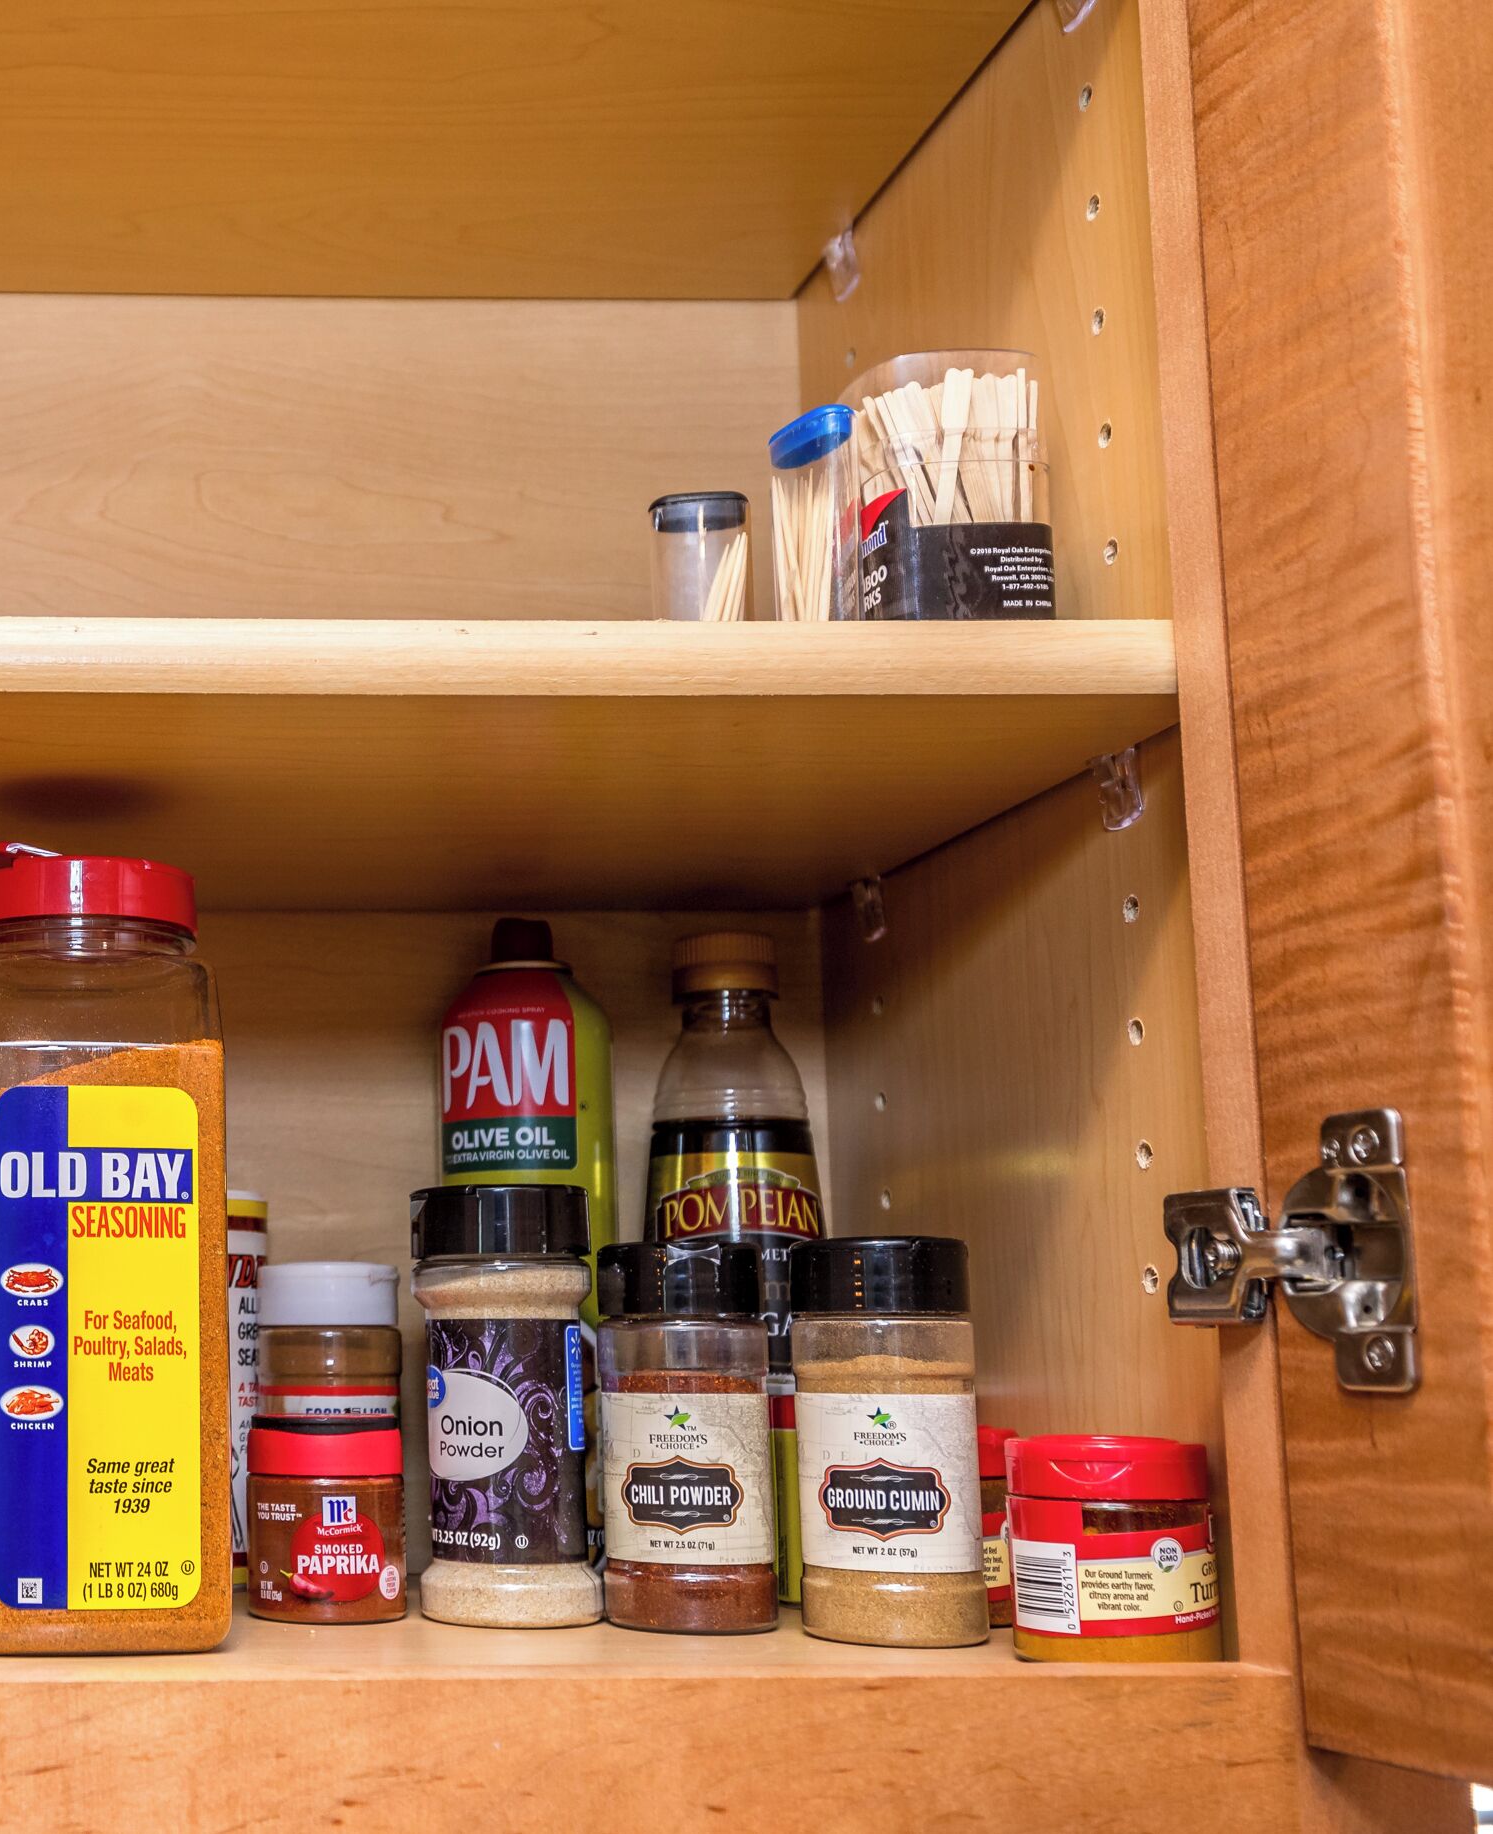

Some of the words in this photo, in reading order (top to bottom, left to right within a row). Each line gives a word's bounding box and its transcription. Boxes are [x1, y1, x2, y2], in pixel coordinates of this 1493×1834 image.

[992, 547, 1011, 555] Royal
[1000, 556, 1035, 564] Distributed
[984, 565, 1003, 573] Royal
[1003, 565, 1016, 573] Oak
[1003, 600, 1023, 608] MADE
[442, 1018, 570, 1114] PAM
[452, 1127, 509, 1150] OLIVE
[515, 1126, 556, 1147] OIL
[453, 1151, 479, 1164] EXTRA
[479, 1150, 515, 1162] VIRGIN
[516, 1149, 550, 1161] OLIVE
[552, 1149, 570, 1160] OIL
[0, 1151, 87, 1199] OLD
[664, 1188, 820, 1239] POMPEIAN
[72, 1206, 186, 1239] SEASONING
[17, 1299, 49, 1307] CRABS
[84, 1310, 109, 1330] For
[113, 1310, 177, 1333] Seafood,
[73, 1336, 130, 1360] Poultry,
[134, 1336, 187, 1359] Salads,
[108, 1362, 154, 1382] Meats
[10, 1422, 55, 1430] CHICKEN
[441, 1415, 503, 1437] Onion
[649, 1433, 708, 1445] FREEDOM'S
[853, 1431, 906, 1442] FREEDOM'S
[440, 1441, 504, 1458] Powder
[86, 1458, 130, 1474] Same
[134, 1457, 175, 1477] great
[89, 1479, 128, 1494] taste
[131, 1478, 172, 1493] since
[631, 1484, 663, 1505] CHILI
[670, 1486, 732, 1506] POWDER
[827, 1488, 886, 1511] GROUND
[890, 1490, 940, 1512] CUMIN
[113, 1498, 151, 1514] 1939
[257, 1503, 270, 1511] THE
[271, 1503, 296, 1512] TASTE
[257, 1512, 269, 1520] YOU
[315, 1523, 363, 1537] McCormick
[438, 1530, 454, 1544] 3.25
[455, 1531, 468, 1545] OZ
[470, 1531, 500, 1550] (92g)
[650, 1540, 661, 1548] NET
[664, 1540, 674, 1548] WT
[676, 1541, 685, 1549] 2.5
[687, 1541, 696, 1549] OZ
[698, 1541, 715, 1550] (71g)
[314, 1544, 363, 1555] SMOKED
[852, 1546, 865, 1555] NET
[867, 1546, 878, 1555] WT
[880, 1547, 886, 1555] 2
[887, 1547, 897, 1556] OZ
[899, 1548, 917, 1558] (57g)
[1159, 1547, 1177, 1555] NON
[297, 1554, 380, 1575] PAPRIKA
[1159, 1554, 1178, 1562] GMO
[89, 1563, 112, 1578] NET
[115, 1562, 134, 1578] WT
[137, 1562, 151, 1577] 24
[154, 1561, 168, 1577] OZ
[1084, 1569, 1096, 1578] Our
[1098, 1570, 1123, 1580] Ground
[1124, 1570, 1153, 1580] Turmeric
[82, 1583, 93, 1601] (1
[98, 1583, 113, 1598] LB
[116, 1583, 124, 1598] 8
[127, 1582, 147, 1601] OZ)
[150, 1582, 179, 1600] 680g
[1081, 1580, 1109, 1590] provides
[1111, 1580, 1133, 1591] earthy
[1134, 1581, 1156, 1591] flavor,
[1089, 1591, 1111, 1601] citrusy
[1113, 1593, 1134, 1601] aroma
[1135, 1592, 1149, 1601] and
[1097, 1602, 1122, 1611] vibrant
[1124, 1602, 1142, 1611] color.
